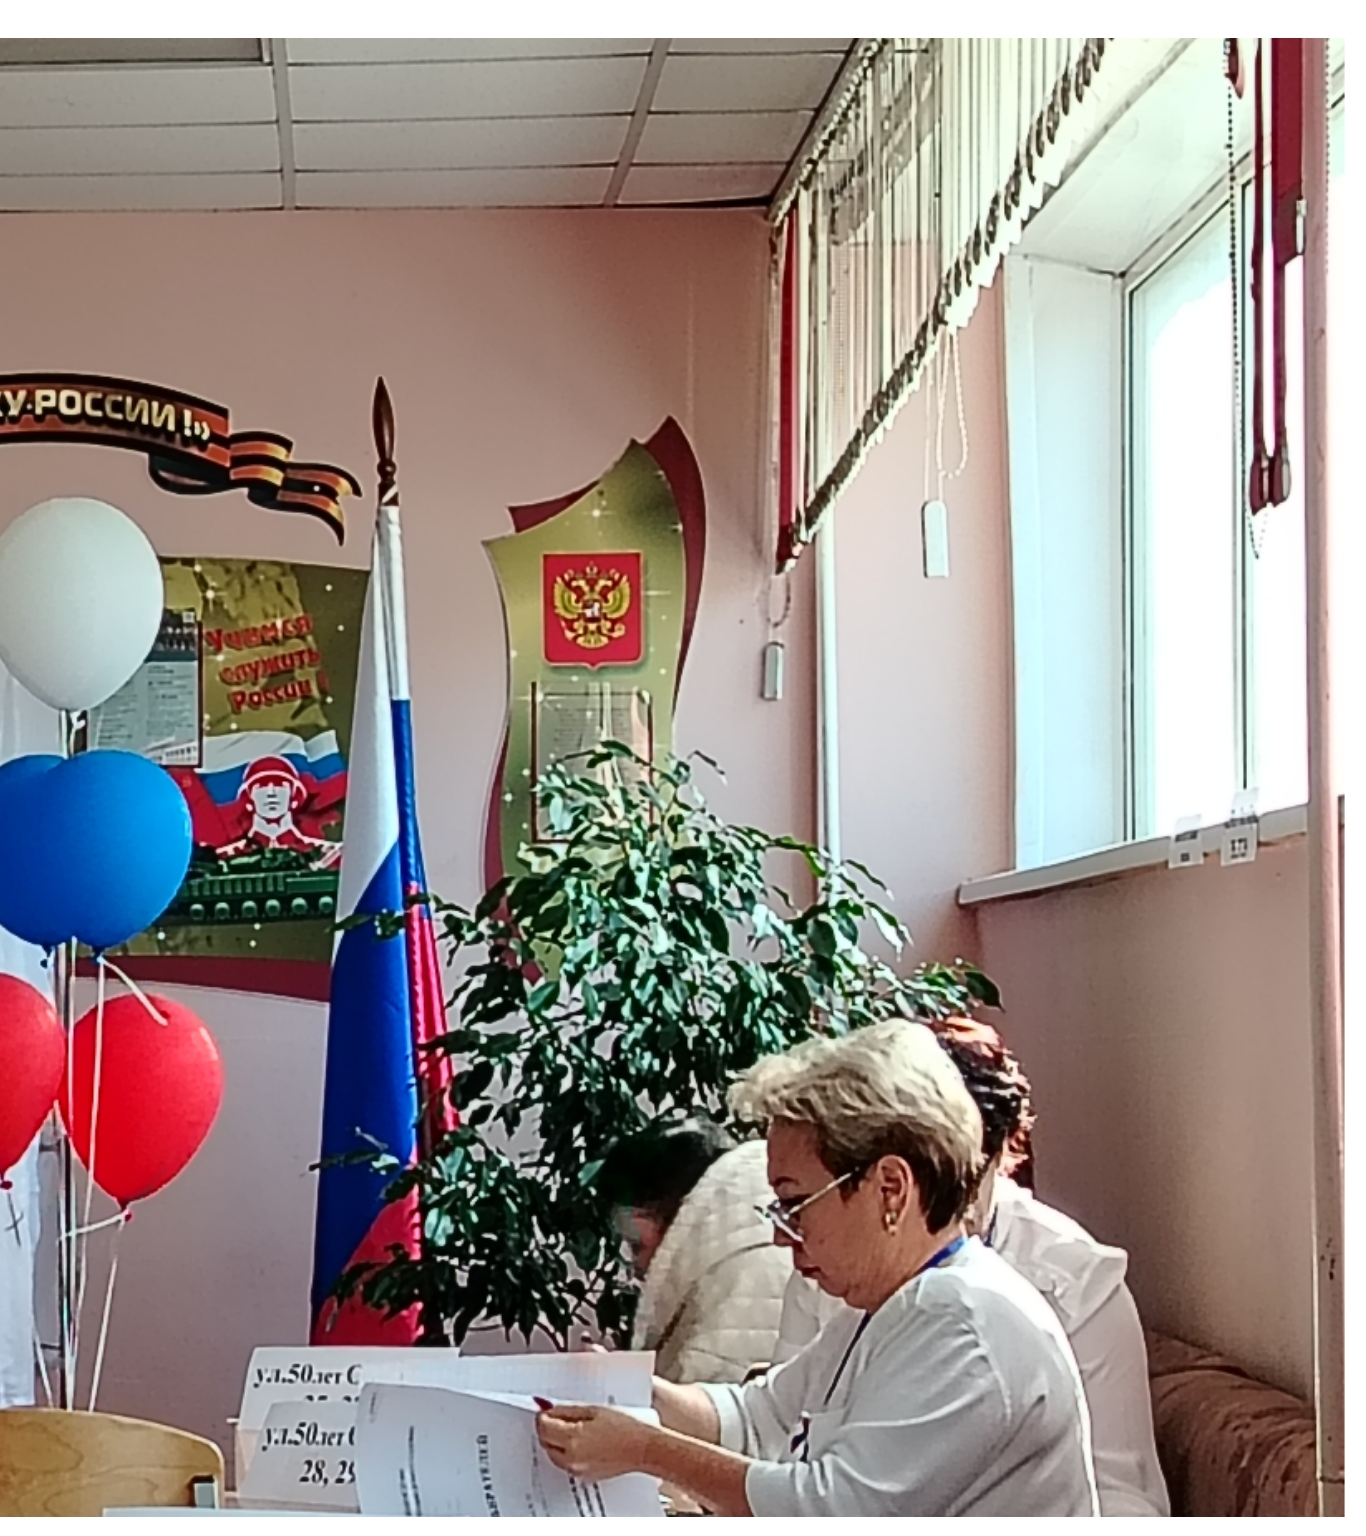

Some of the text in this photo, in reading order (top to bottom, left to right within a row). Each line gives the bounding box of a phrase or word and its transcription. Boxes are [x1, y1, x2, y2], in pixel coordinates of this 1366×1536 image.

[35, 388, 176, 432] РОССИИ
[204, 614, 313, 654] Учимся
[298, 1459, 329, 1488] 28,
